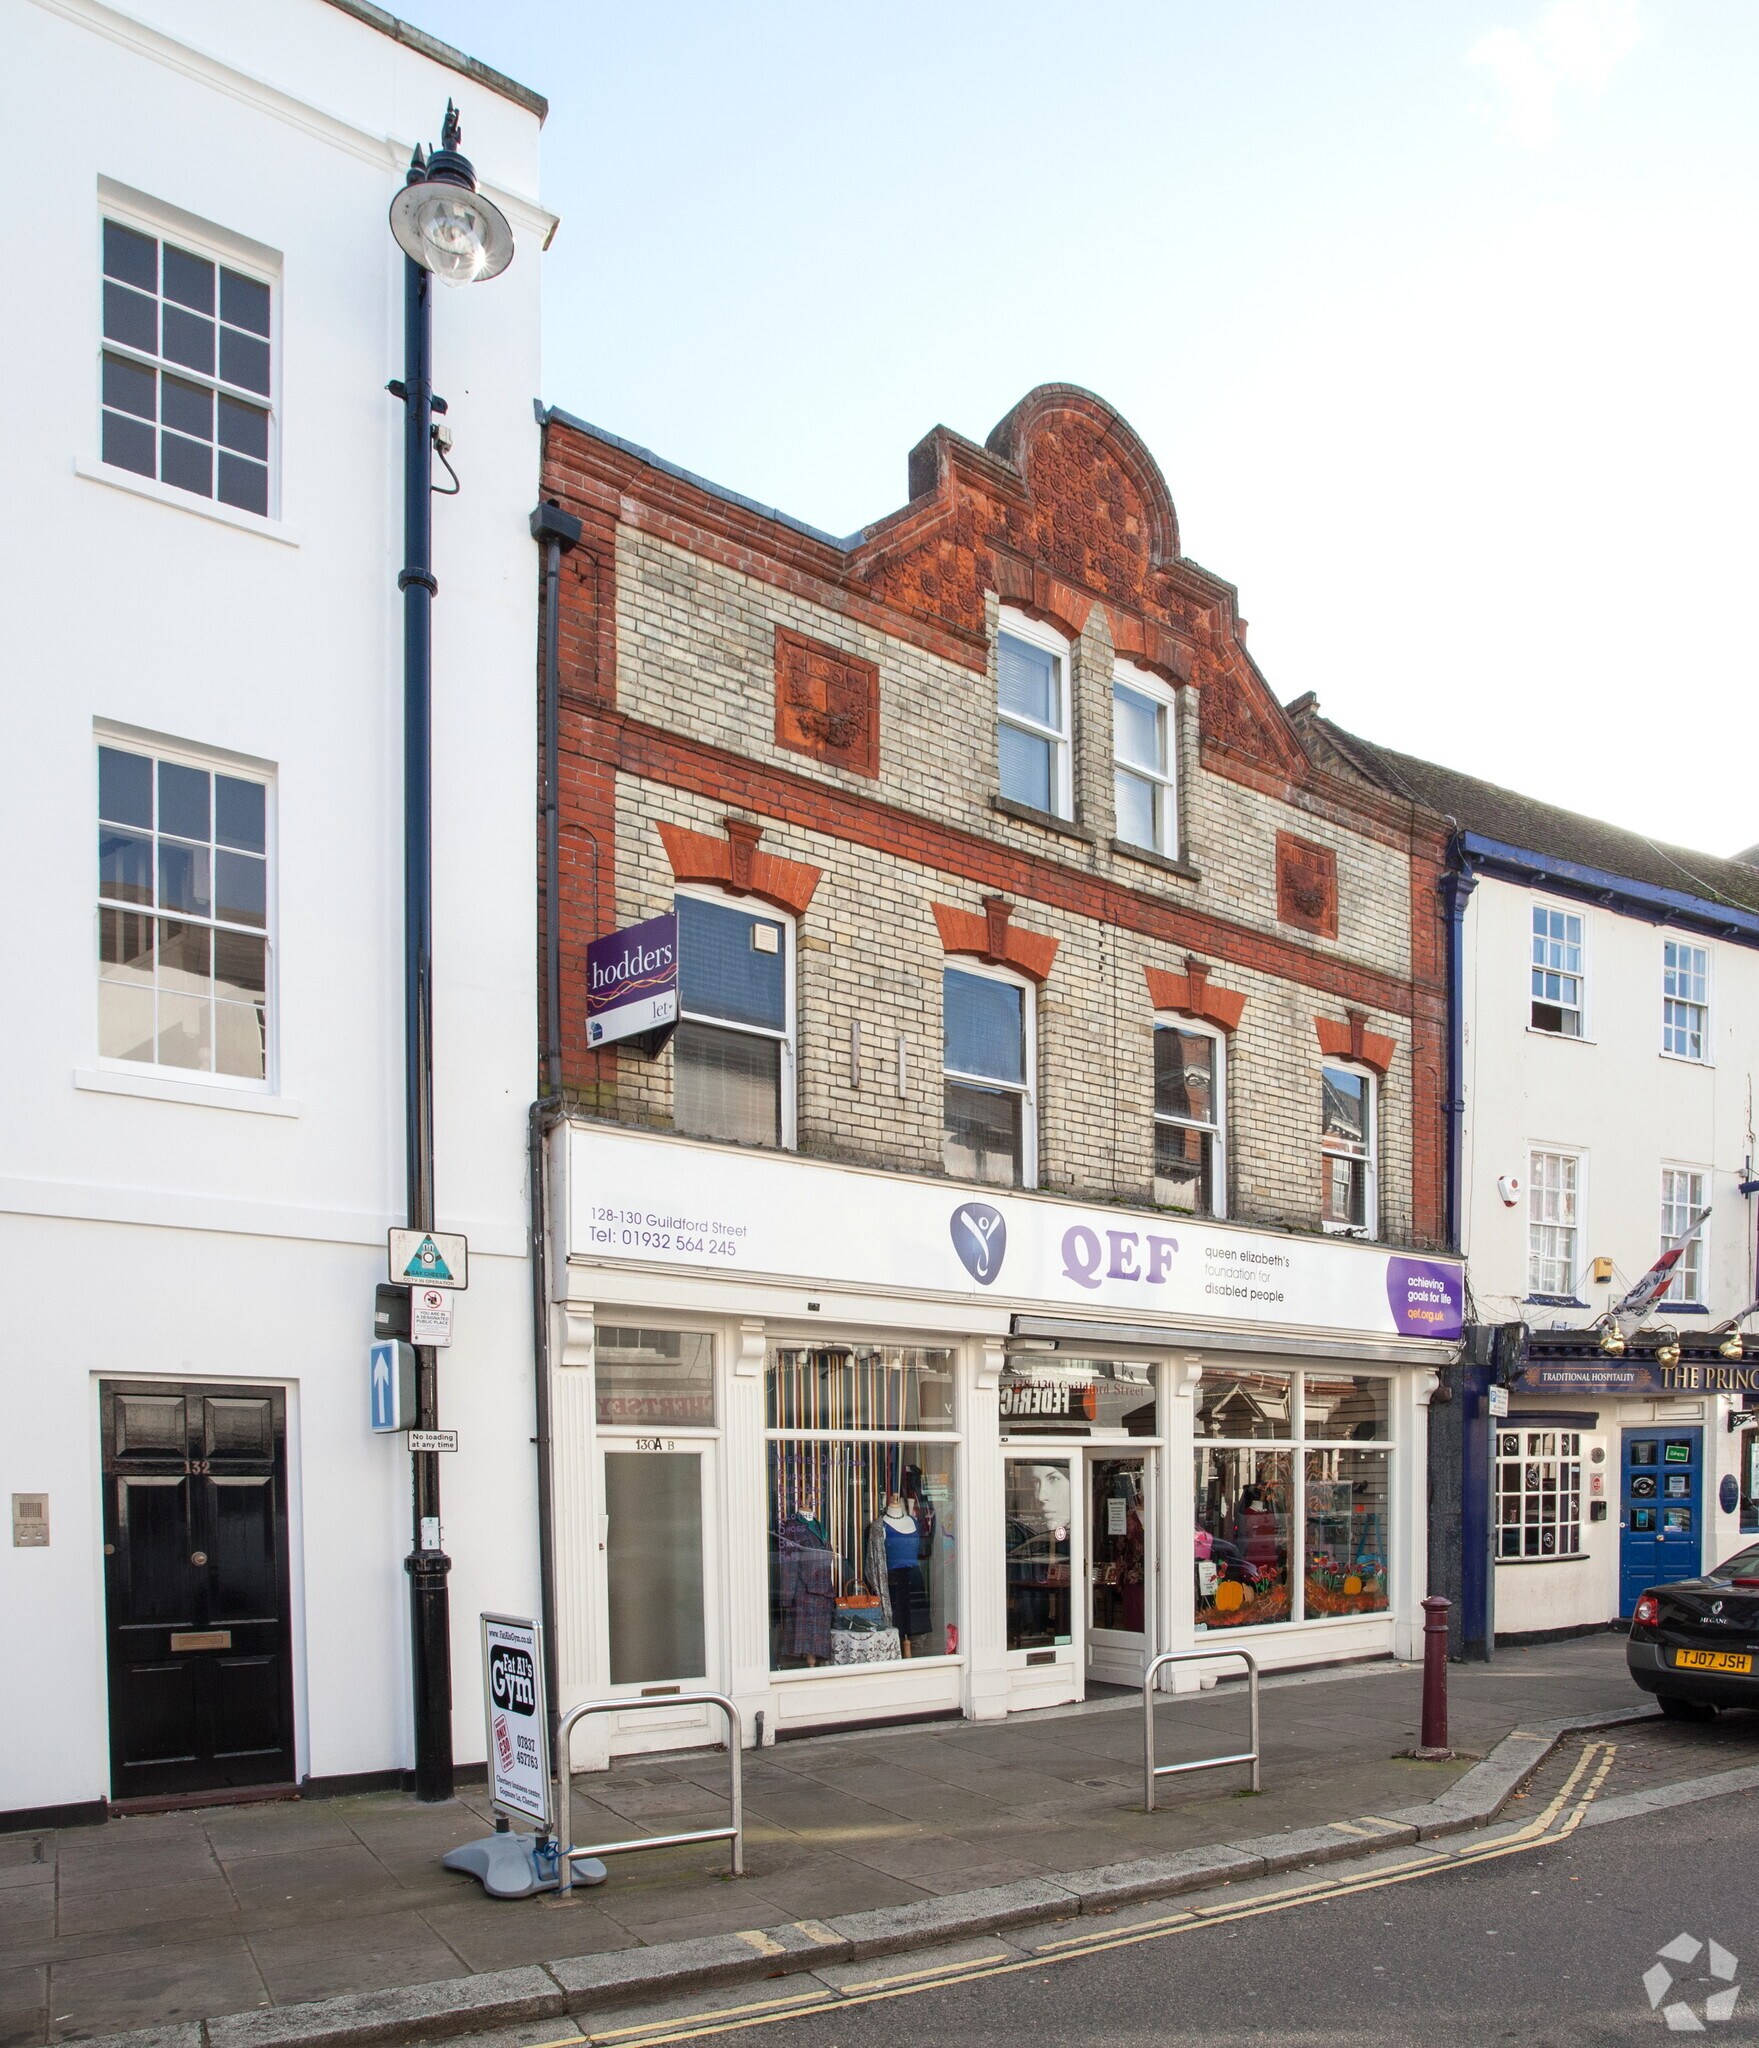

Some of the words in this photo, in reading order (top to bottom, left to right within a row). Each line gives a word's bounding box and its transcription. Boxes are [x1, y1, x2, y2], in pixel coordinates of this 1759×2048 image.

[592, 944, 673, 989] hodders
[653, 1001, 667, 1018] let
[591, 1207, 642, 1225] 128-130
[646, 1214, 708, 1232] Guildford
[712, 1221, 747, 1237] Street
[589, 1226, 616, 1243] Tel:
[622, 1229, 671, 1249] 01932
[676, 1235, 704, 1252] 564
[708, 1239, 736, 1256] 245
[1061, 1225, 1179, 1289] QEF
[1205, 1247, 1237, 1260] queen
[1240, 1251, 1290, 1267] elizabeth's
[1205, 1263, 1255, 1280] foundation
[1259, 1270, 1270, 1282] for
[1205, 1283, 1247, 1298] disabled
[1250, 1289, 1284, 1303] people
[1408, 1277, 1444, 1292] achieving
[1408, 1291, 1428, 1302] goals
[1430, 1292, 1439, 1302] for
[1441, 1294, 1451, 1304] life
[1408, 1308, 1444, 1322] qef.org.uk
[1542, 1372, 1590, 1381] TRADITIONAL
[1592, 1373, 1635, 1382] HOSPITALITY
[1661, 1367, 1699, 1388] THE
[1060, 1380, 1109, 1395] Guildford
[1114, 1383, 1144, 1396] Street
[636, 1438, 662, 1450] 130A
[667, 1441, 674, 1450] B
[184, 1460, 210, 1475] 132
[778, 1522, 806, 1535] SHOES
[503, 1653, 515, 1674] Fat
[517, 1656, 532, 1678] Al's
[1683, 1651, 1715, 1666] TJ07
[1719, 1655, 1746, 1669] JSH
[493, 1659, 534, 1710] Gym
[517, 1734, 535, 1752] 07837
[517, 1750, 539, 1770] 457763
[496, 1774, 511, 1788] Chertsey
[512, 1781, 527, 1793] business
[522, 1796, 538, 1810] Chertsey
